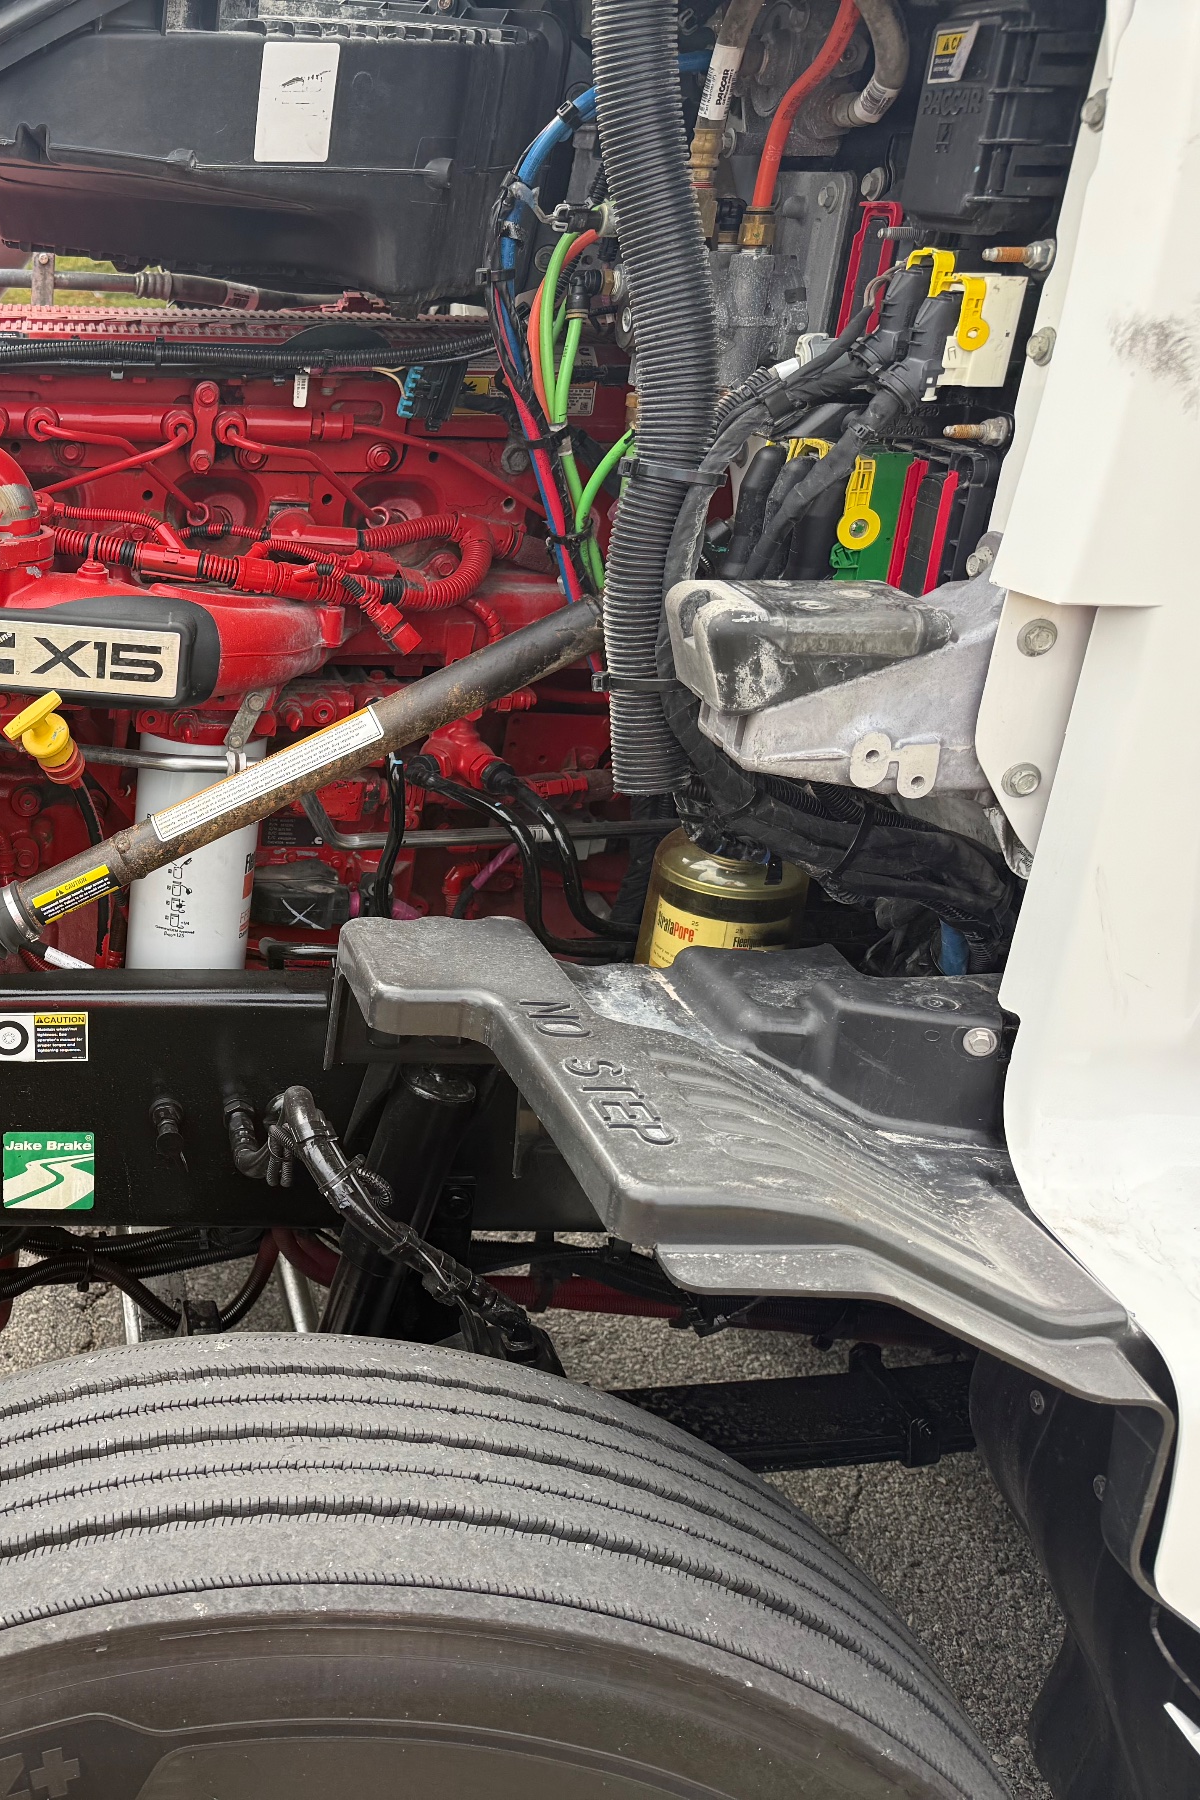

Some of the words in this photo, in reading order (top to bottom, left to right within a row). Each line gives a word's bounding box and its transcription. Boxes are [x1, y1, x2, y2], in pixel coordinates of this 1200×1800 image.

[715, 69, 730, 105] PACCAR
[921, 87, 984, 115] PACCAR
[30, 636, 163, 682] X15
[64, 877, 87, 891] CAUTION
[519, 1000, 592, 1038] NO
[563, 1057, 680, 1146] STEP
[5, 1140, 42, 1150] Jake
[46, 1140, 92, 1151] Brake
